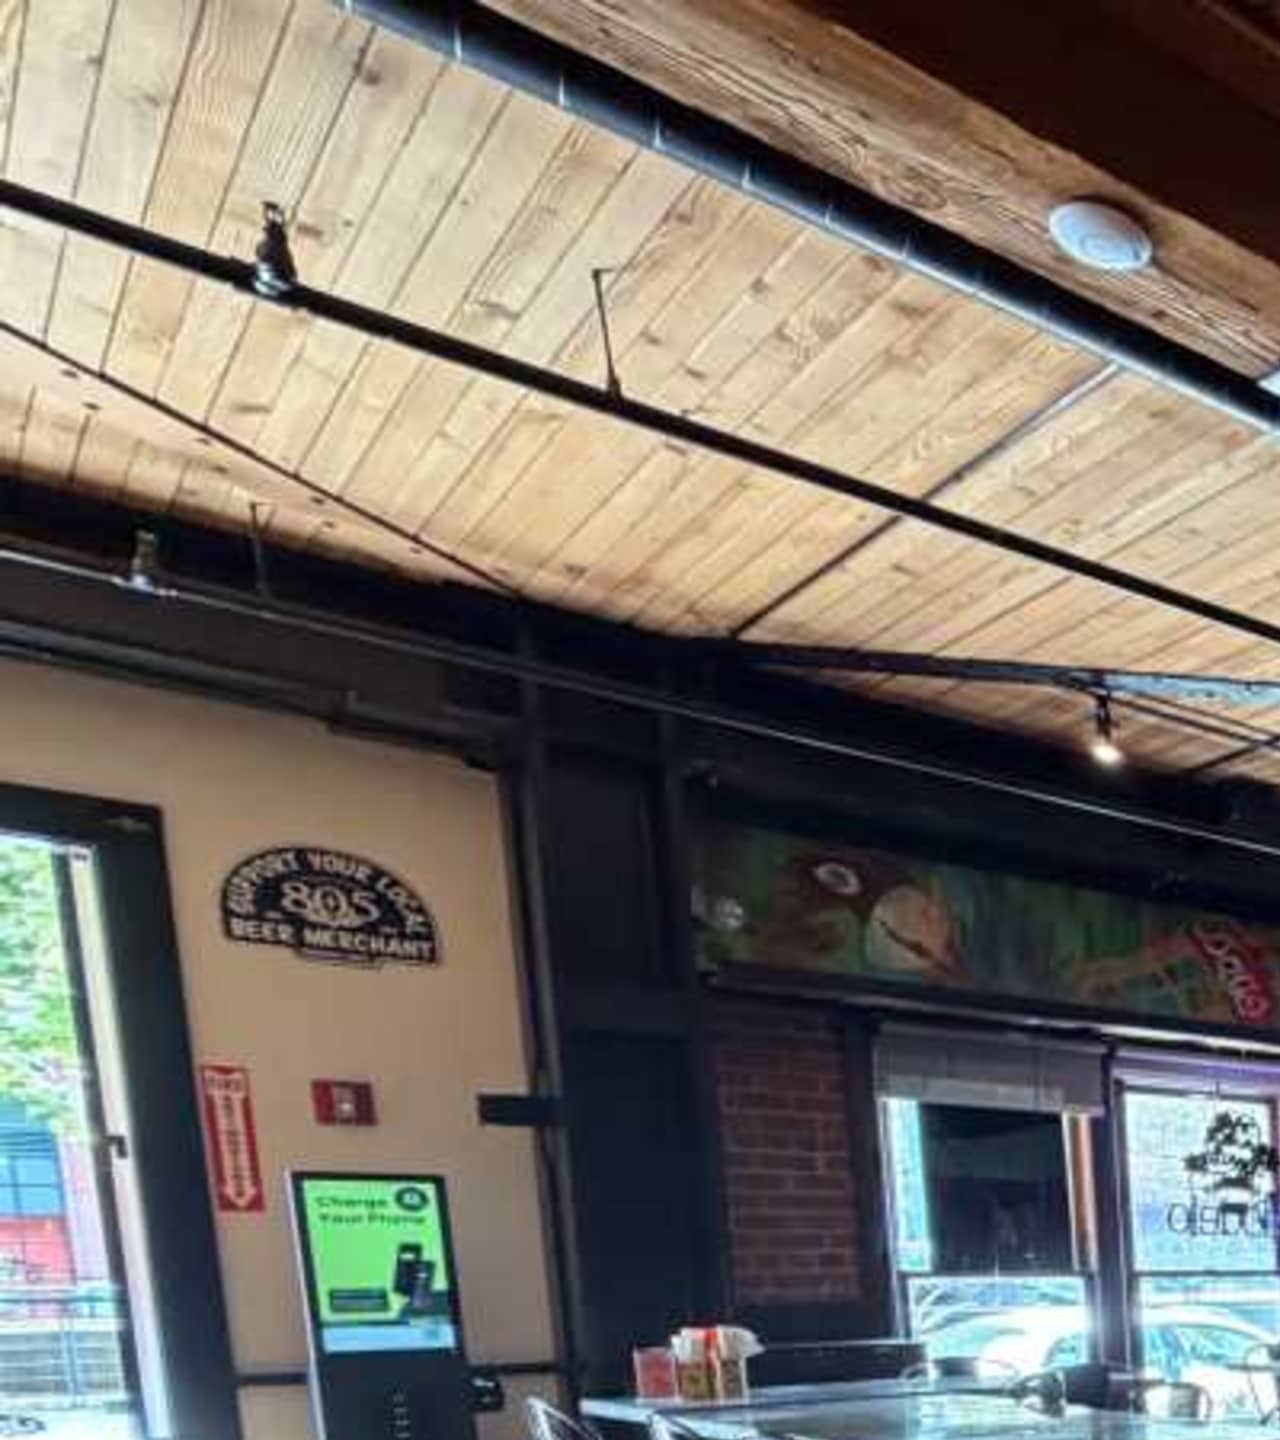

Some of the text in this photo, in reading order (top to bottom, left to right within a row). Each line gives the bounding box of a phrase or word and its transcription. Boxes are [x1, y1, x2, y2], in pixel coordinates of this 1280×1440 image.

[226, 851, 434, 936] SUPPORT YOUR LOCAL
[280, 880, 381, 925] 805
[229, 917, 434, 960] BEER MERCHANT
